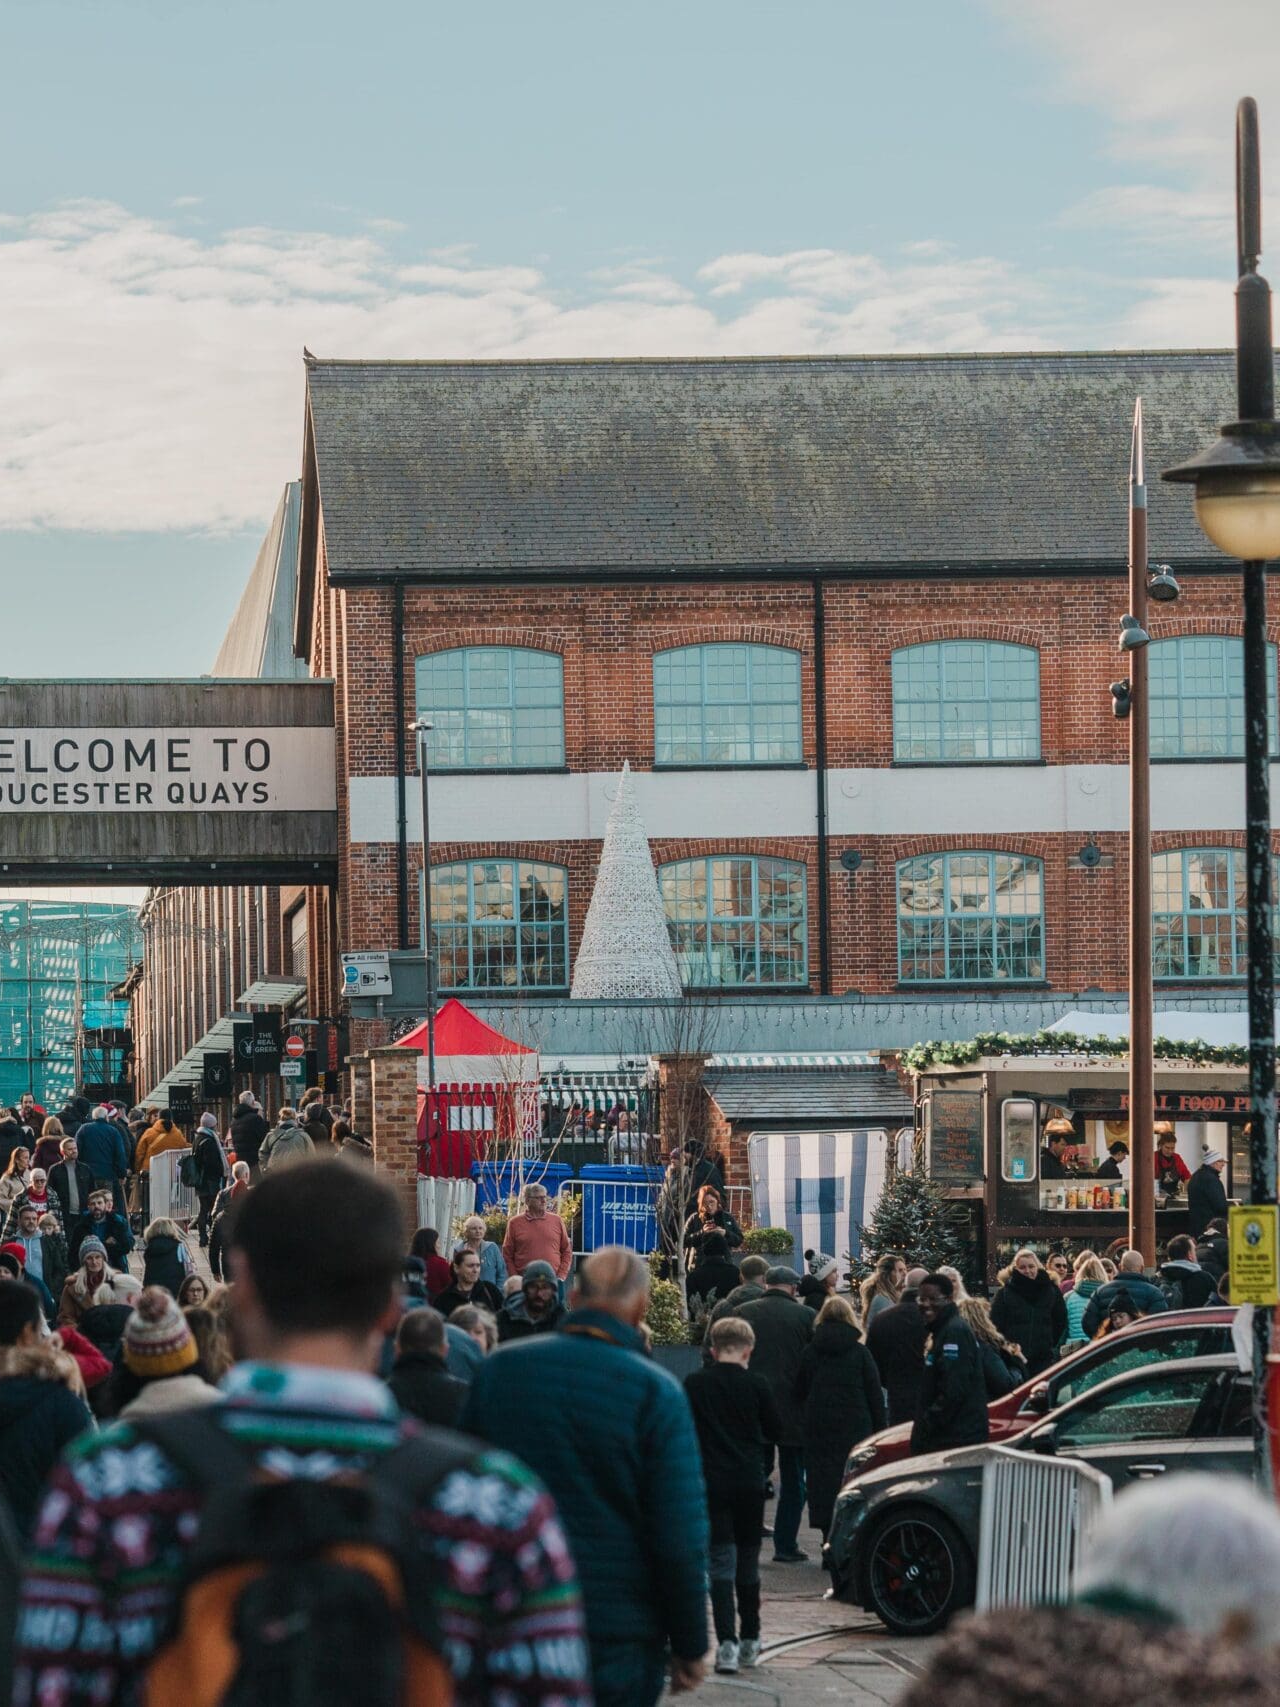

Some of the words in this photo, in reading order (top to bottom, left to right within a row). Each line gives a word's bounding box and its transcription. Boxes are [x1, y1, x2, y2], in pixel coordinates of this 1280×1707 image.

[213, 738, 270, 772] TO
[167, 781, 269, 804] QUAYS
[1179, 1095, 1226, 1112] FOOD
